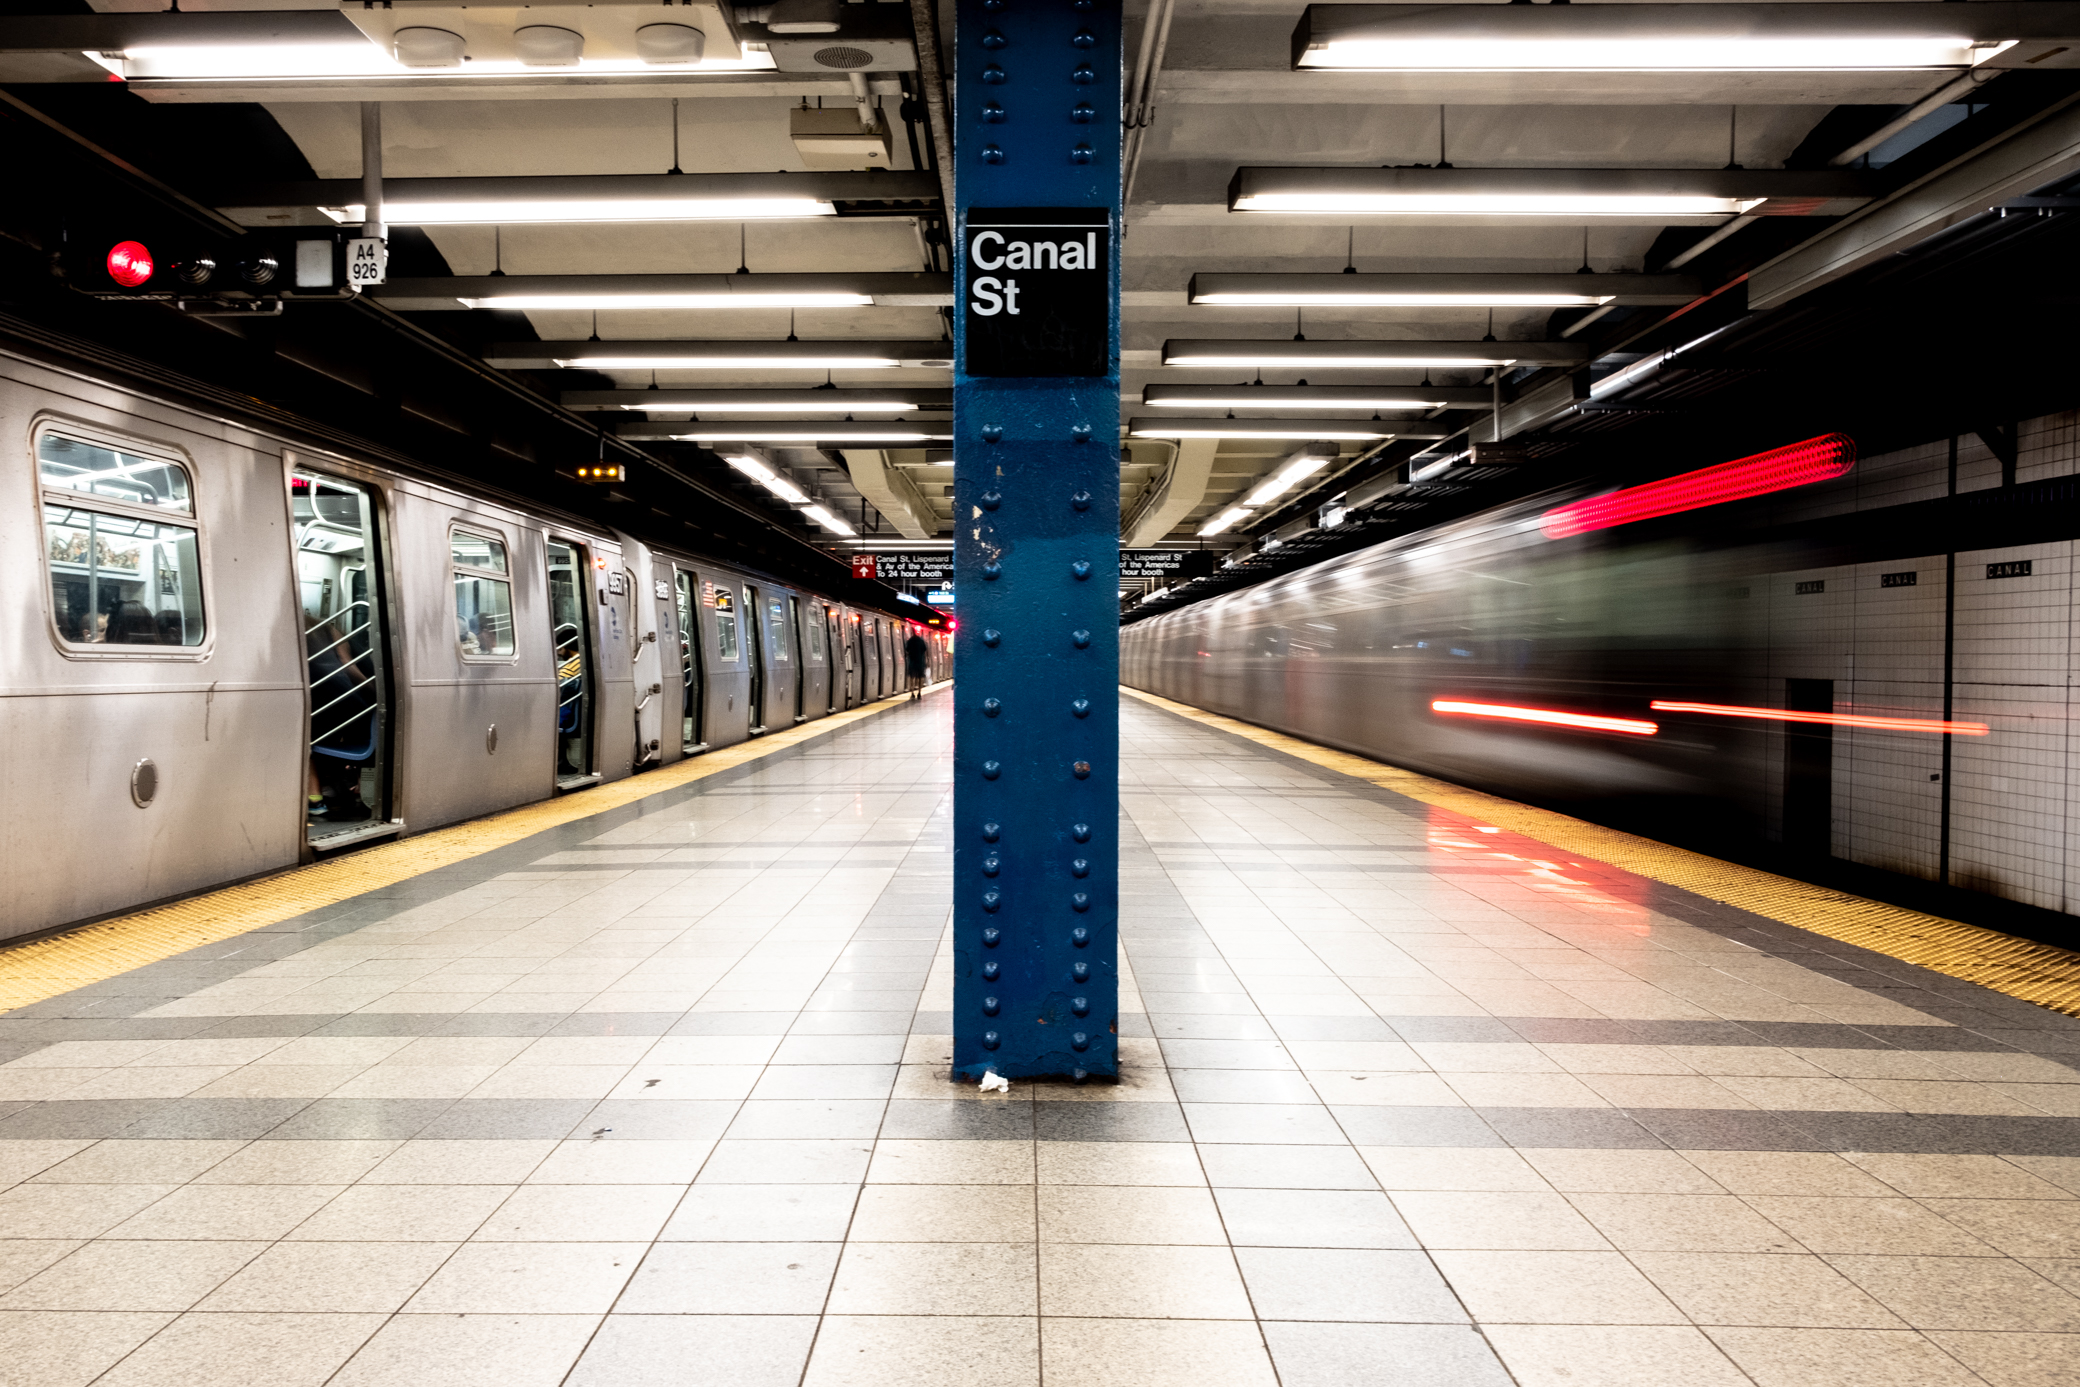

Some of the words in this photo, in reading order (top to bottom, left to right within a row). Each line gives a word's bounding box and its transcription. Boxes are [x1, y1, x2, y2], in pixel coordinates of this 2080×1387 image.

[356, 244, 375, 260] A4
[971, 230, 1096, 271] Canal
[353, 262, 378, 279] 926
[971, 276, 1021, 317] St
[852, 555, 874, 565] Exit
[913, 555, 949, 563] Lispenard
[1134, 553, 1171, 562] Lispenard
[1173, 553, 1183, 561] St
[1987, 562, 2030, 577] CANAL
[1882, 574, 1915, 586] CANAL
[1796, 582, 1823, 594] CANAL
